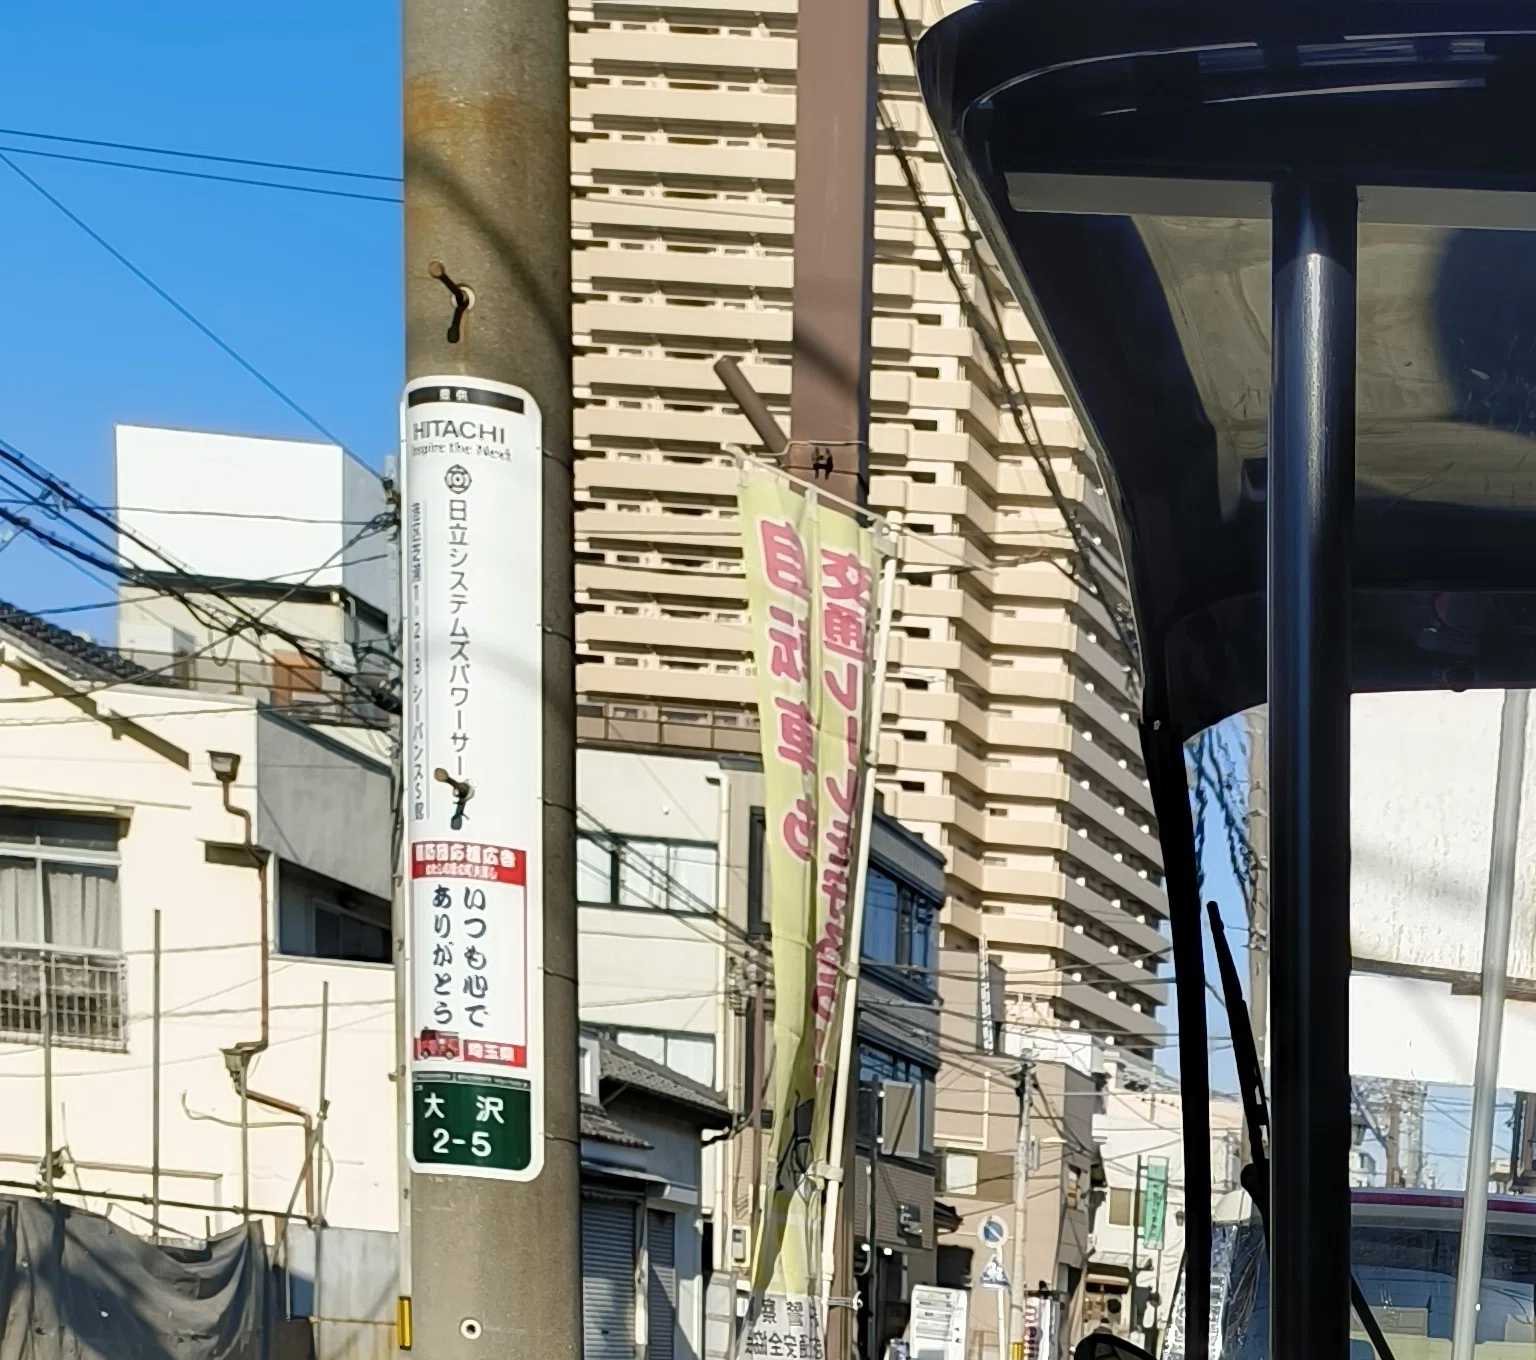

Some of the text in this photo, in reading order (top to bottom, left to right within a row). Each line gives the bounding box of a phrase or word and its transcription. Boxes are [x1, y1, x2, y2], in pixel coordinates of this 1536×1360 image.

[413, 419, 505, 444] HITACHI
[448, 499, 469, 820] 日立システムズパワーサー
[433, 885, 454, 1025] ありがとう
[463, 886, 489, 1028] いつも心で
[432, 1128, 492, 1157] 2-5
